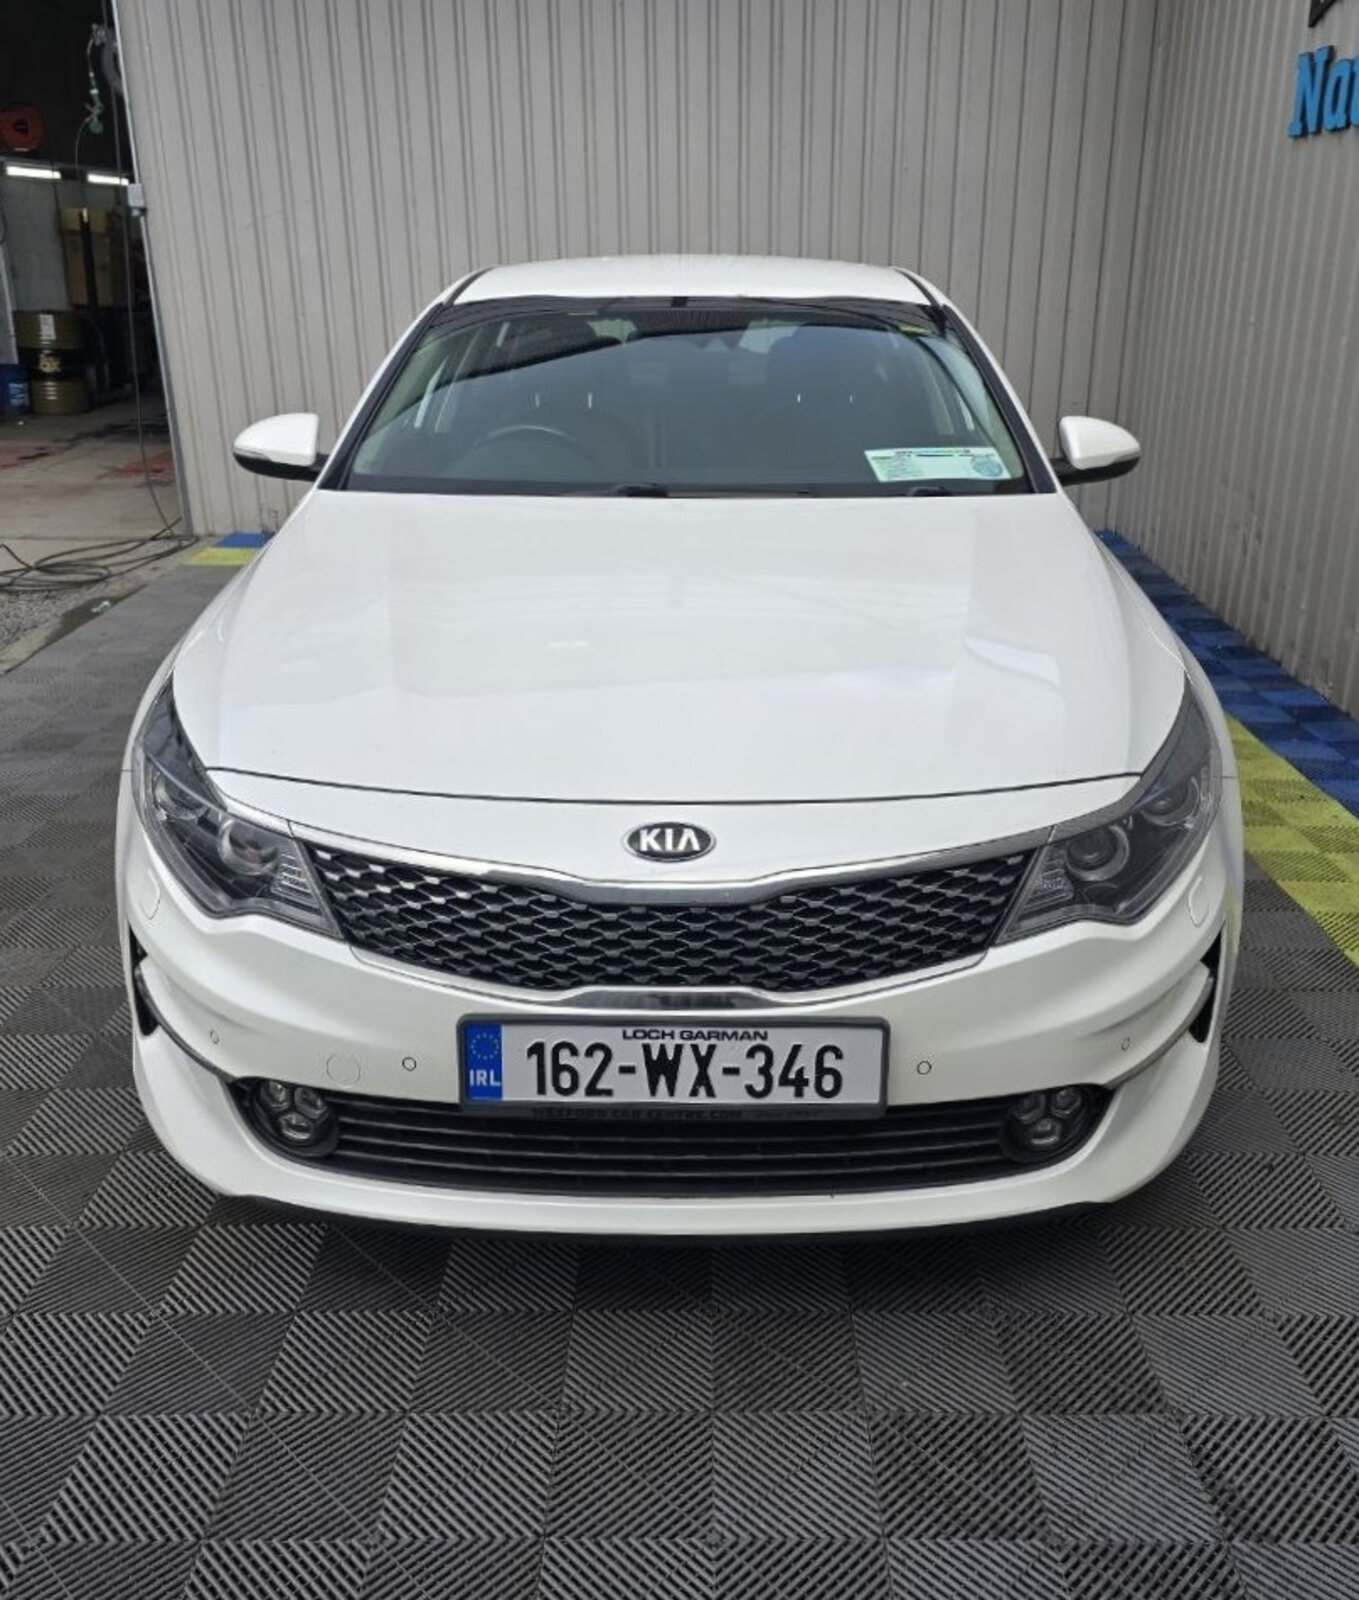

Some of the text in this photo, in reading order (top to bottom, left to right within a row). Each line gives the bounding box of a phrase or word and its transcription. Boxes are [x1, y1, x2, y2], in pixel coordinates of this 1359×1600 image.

[640, 827, 700, 852] KIA
[622, 1029, 768, 1042] LOCH GARMAN
[469, 1069, 502, 1087] IRL
[526, 1041, 844, 1100] 162-WX-346
